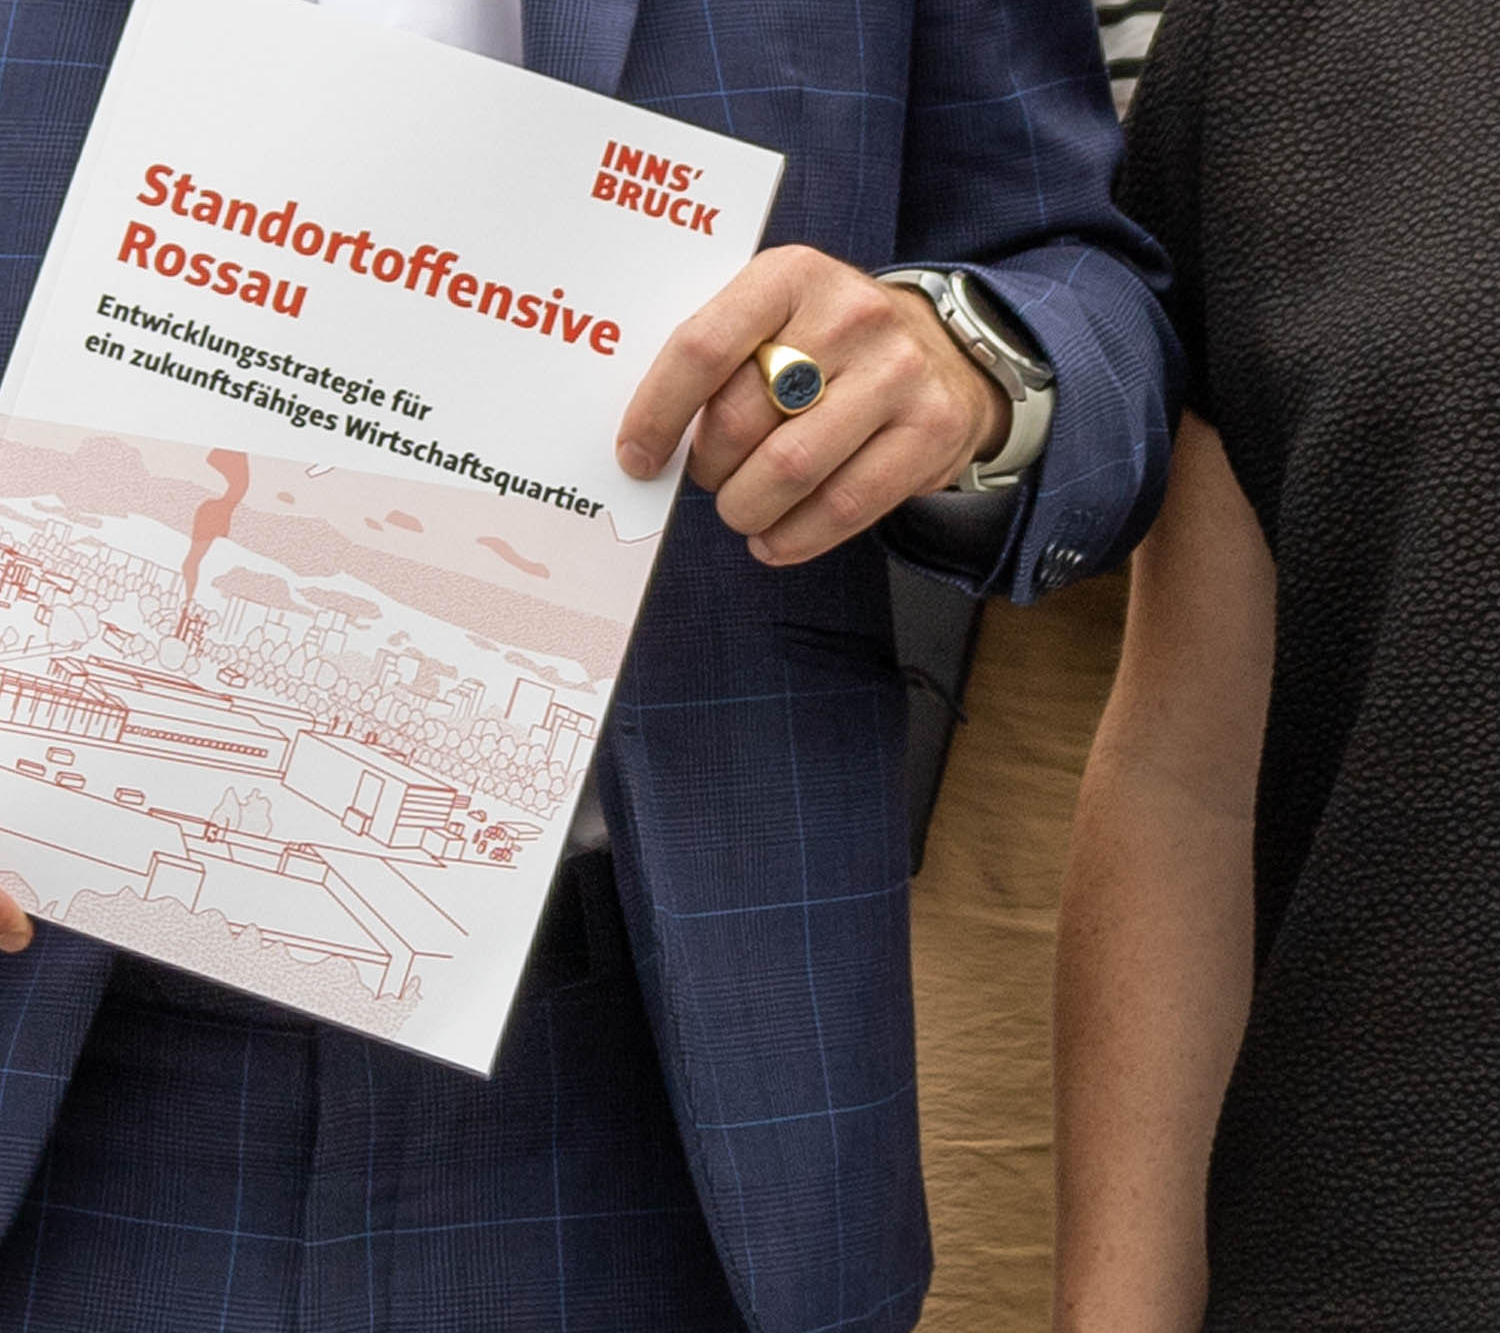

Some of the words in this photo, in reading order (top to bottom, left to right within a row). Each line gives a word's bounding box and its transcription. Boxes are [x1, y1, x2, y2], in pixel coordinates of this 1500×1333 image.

[591, 171, 720, 235] BRUCK
[601, 140, 703, 192] INNS'
[118, 221, 307, 318] Rossau
[137, 164, 622, 356] Standortoffensive
[97, 293, 386, 407] Entwicklungsstrategie
[391, 389, 434, 422] für
[85, 334, 125, 361] ein
[129, 349, 339, 431] zukunftsfähiges
[345, 415, 604, 519] Wirtschaftsquartier
